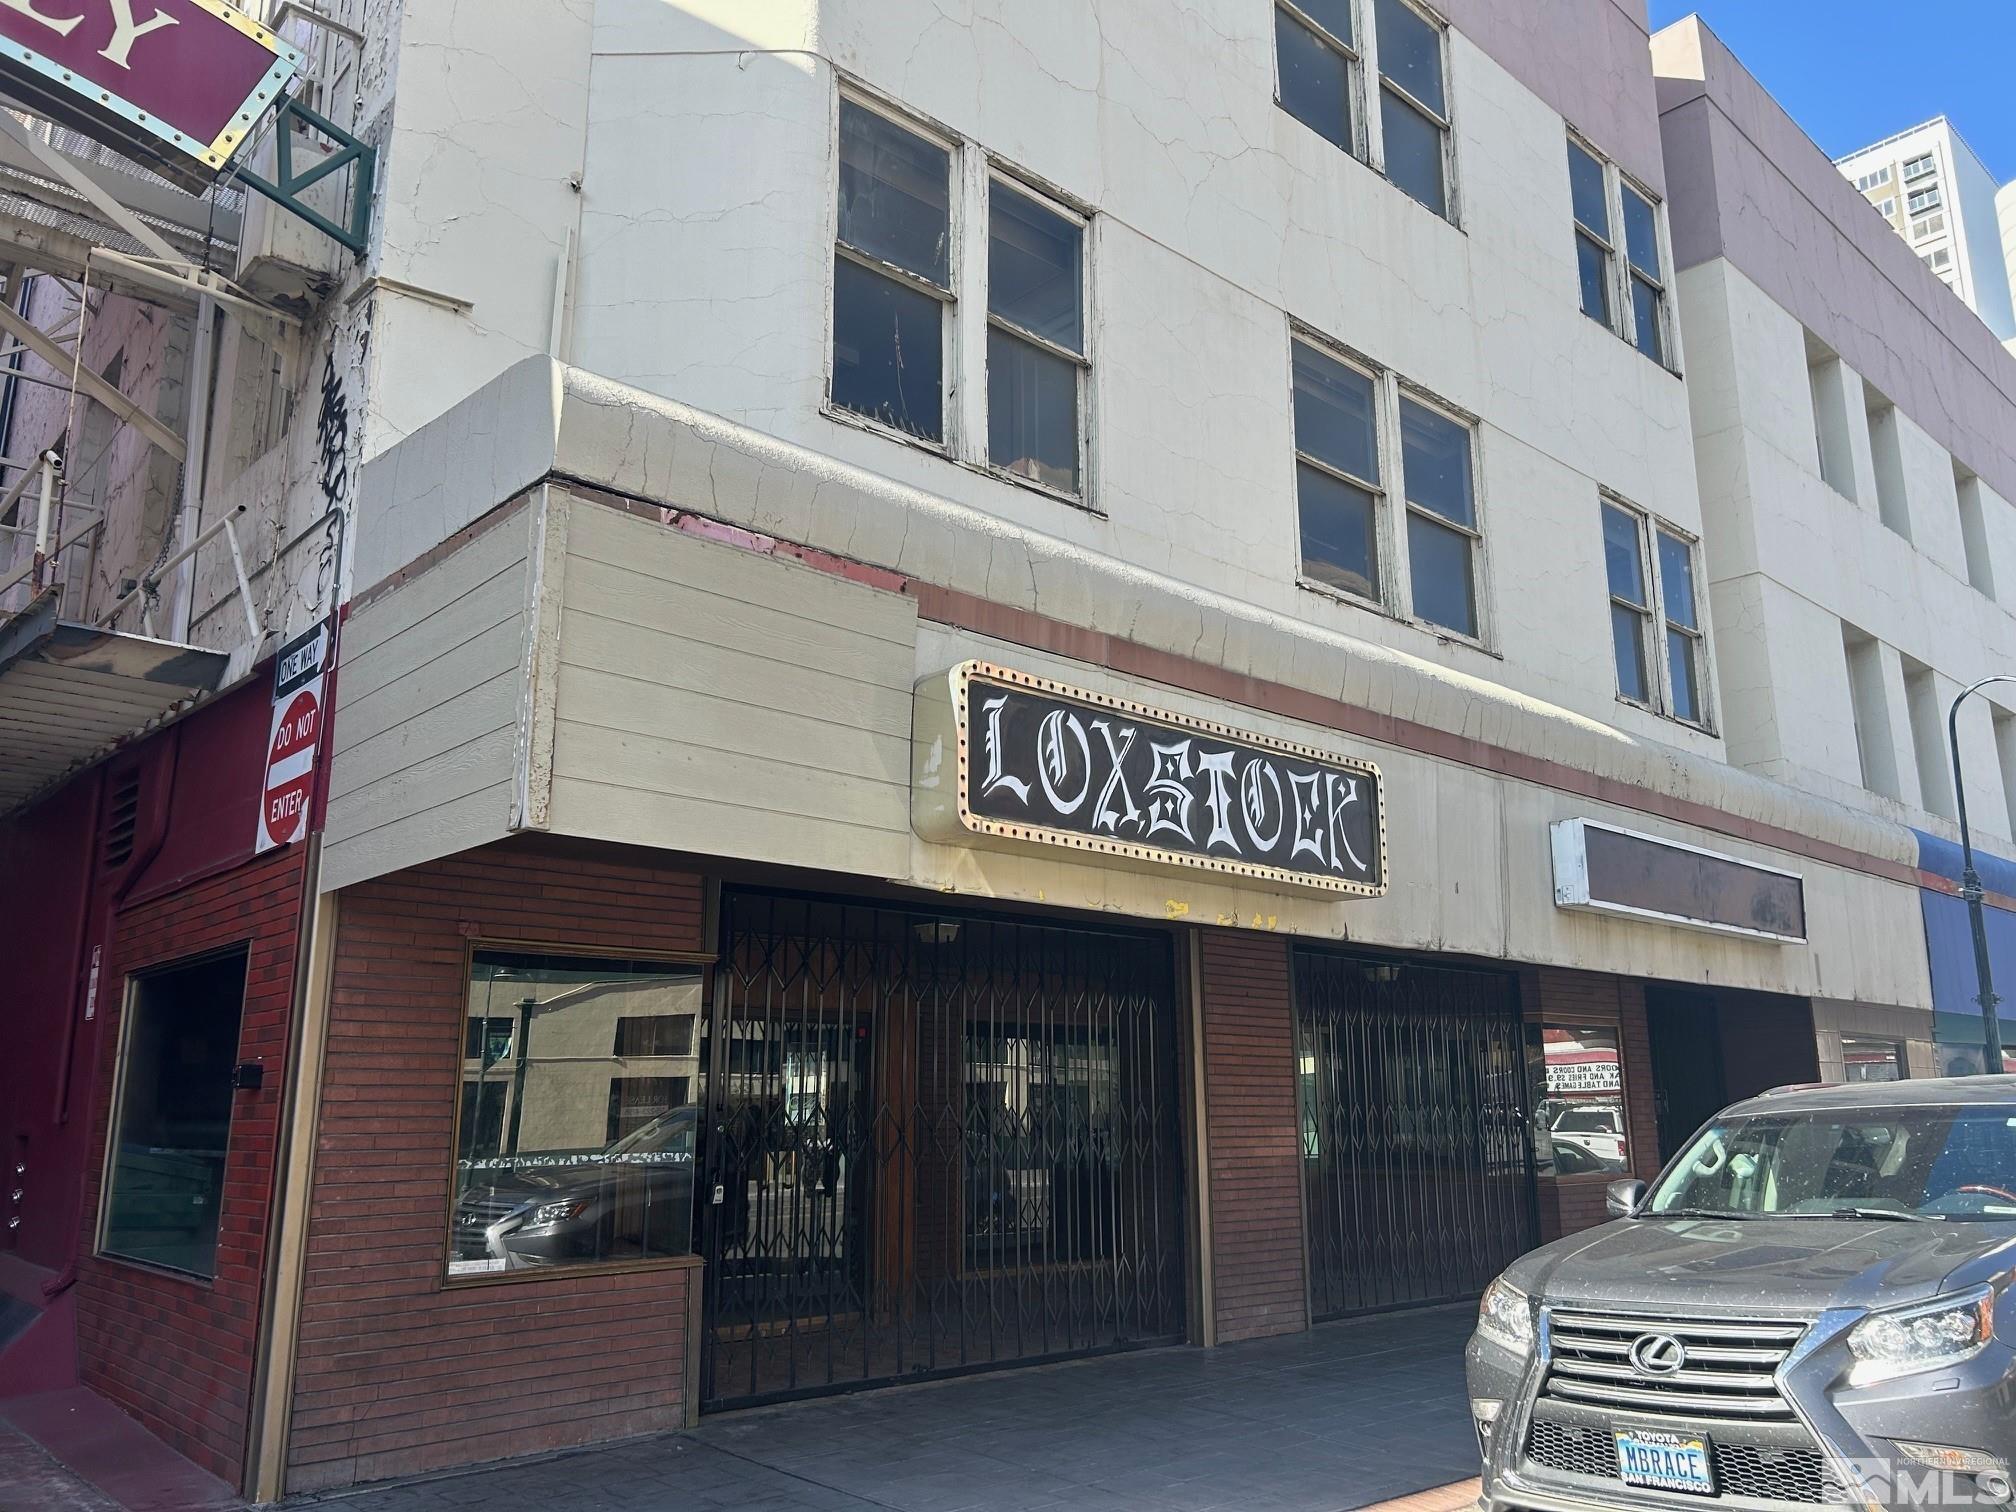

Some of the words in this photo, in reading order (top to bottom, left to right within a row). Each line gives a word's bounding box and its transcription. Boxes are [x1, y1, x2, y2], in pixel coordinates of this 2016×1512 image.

[280, 653, 298, 682] ONE
[301, 641, 319, 674] WAY
[277, 723, 291, 750] DO
[295, 709, 316, 741] NOT
[271, 789, 303, 823] ENTER
[1634, 1430, 1680, 1444] TOYOTA
[1625, 1446, 1702, 1480] MBRACE
[1621, 1472, 1644, 1485] SAN
[1645, 1475, 1711, 1493] FRANCISCO
